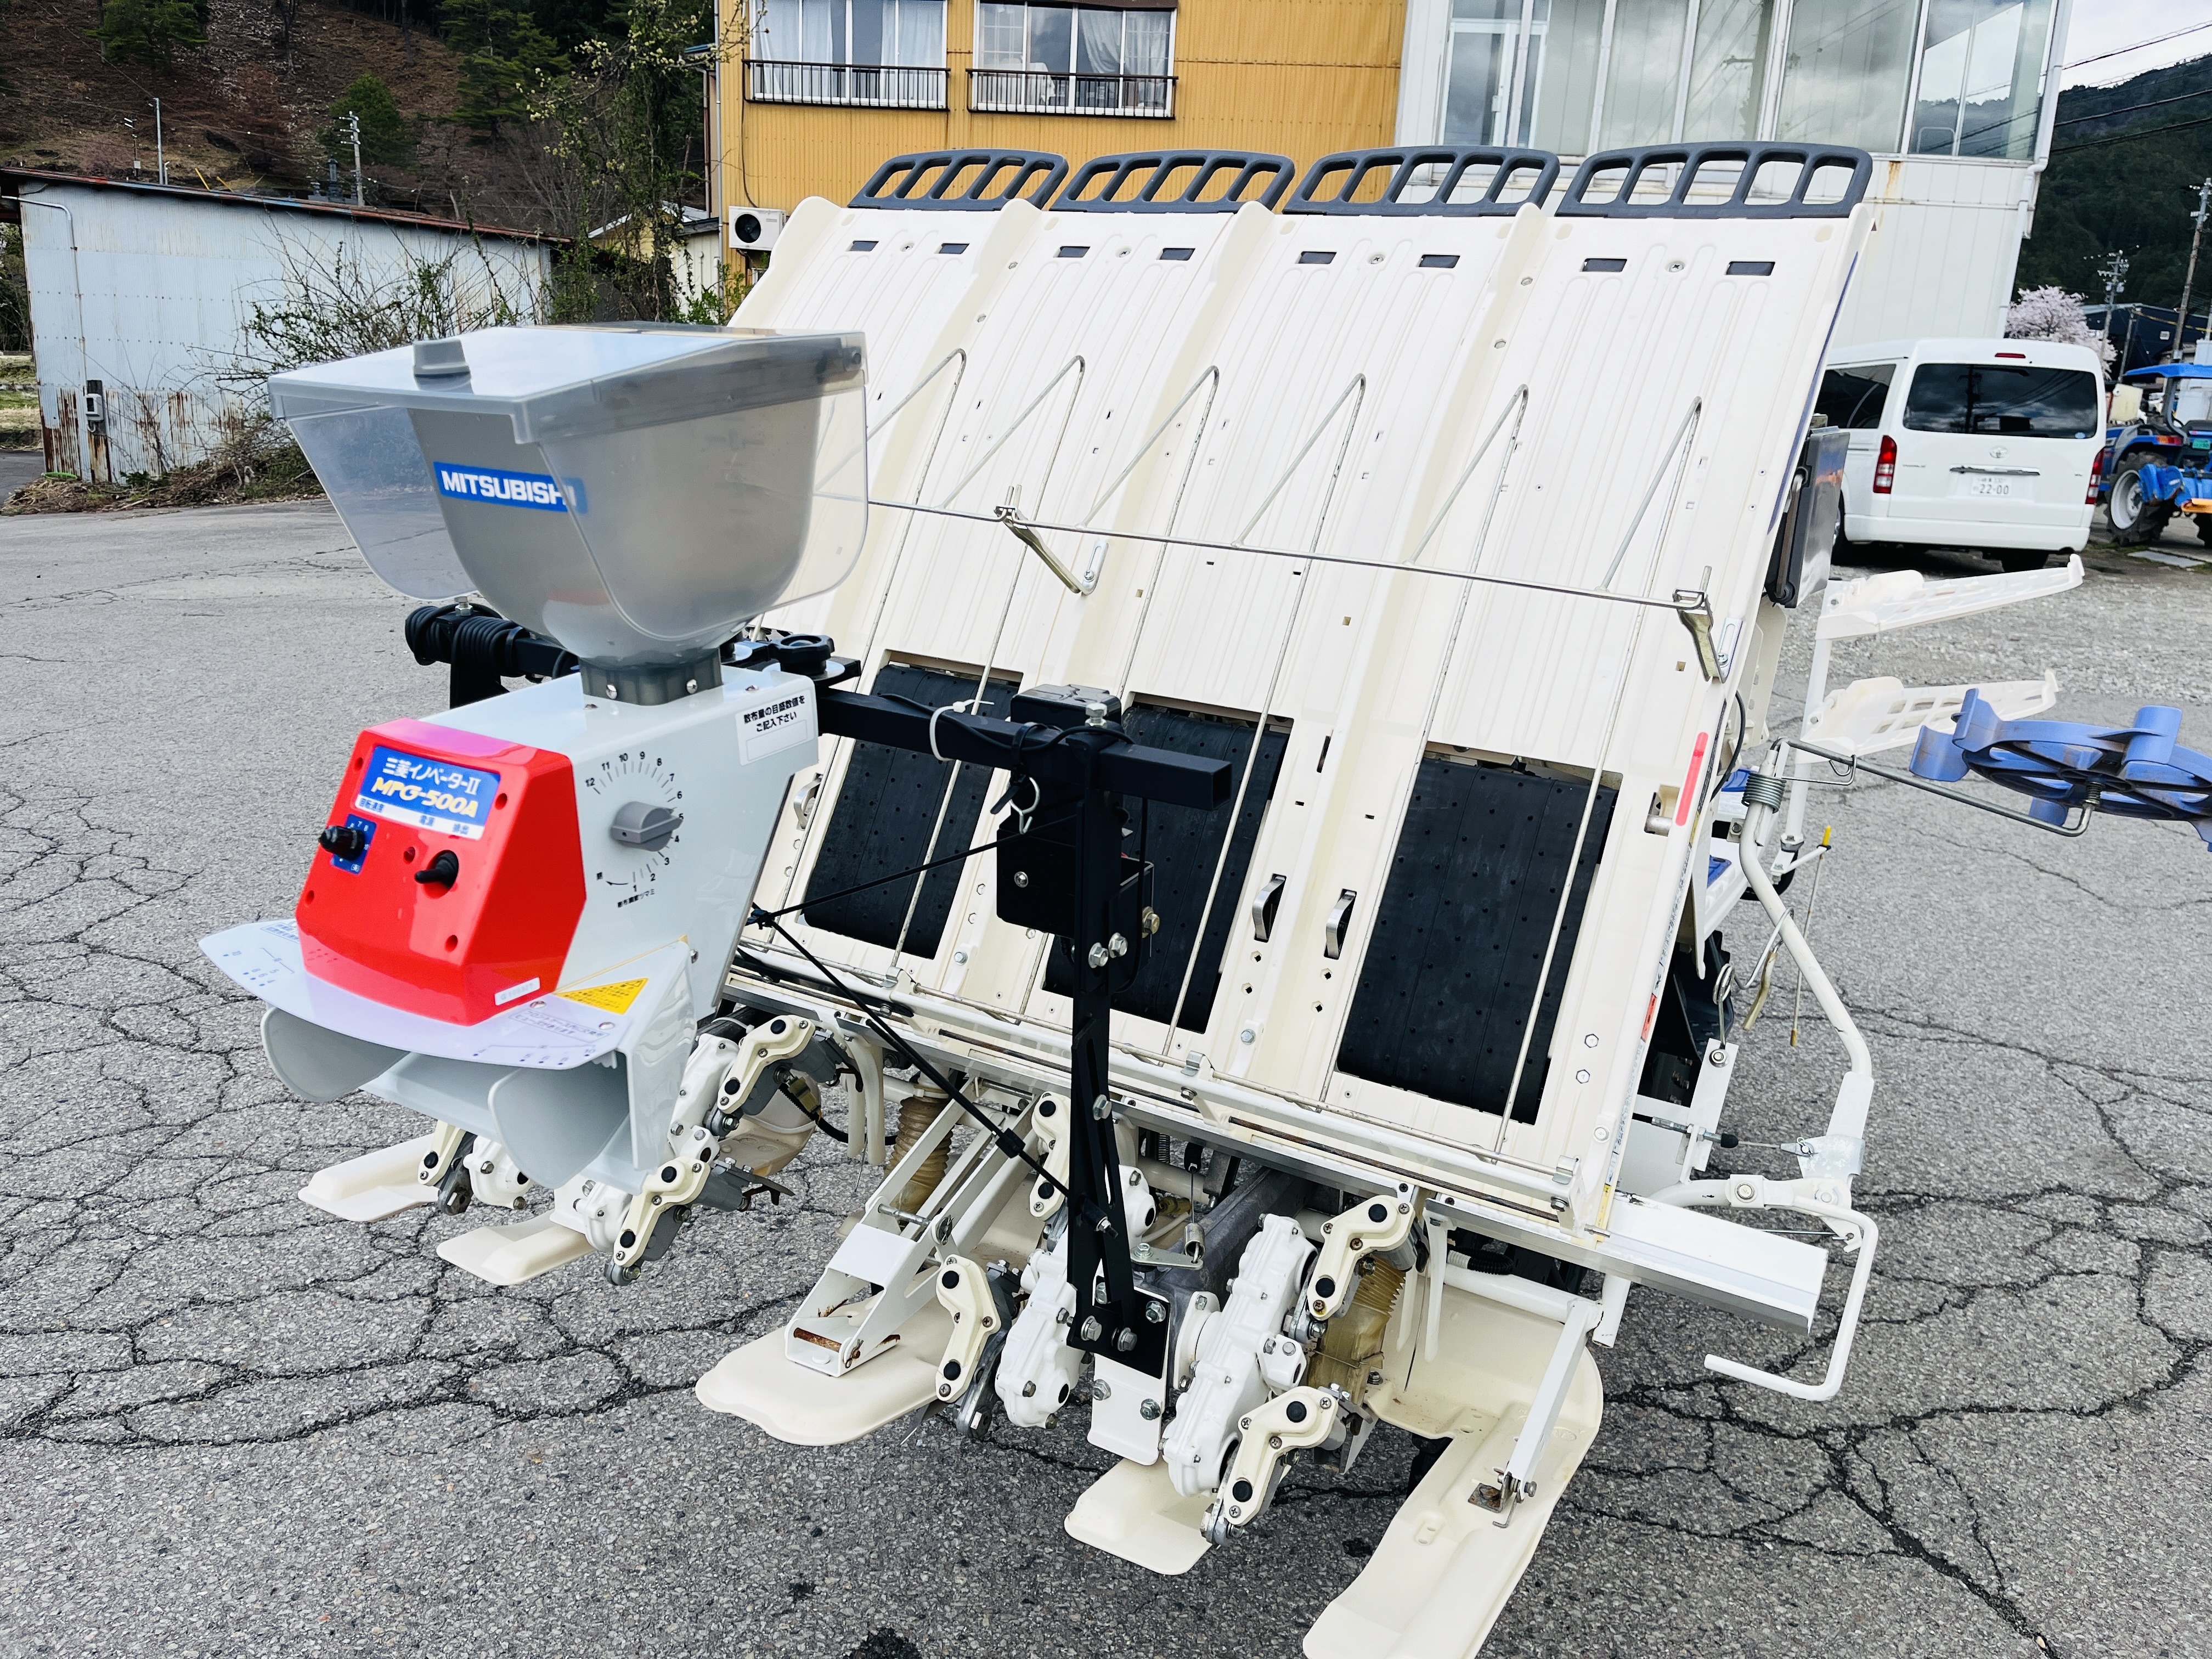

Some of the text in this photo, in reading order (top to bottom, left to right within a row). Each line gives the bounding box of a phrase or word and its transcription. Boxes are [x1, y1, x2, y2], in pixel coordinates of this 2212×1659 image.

[441, 470, 576, 506] MITSUBISHI
[619, 753, 628, 763] 10
[640, 751, 645, 760] 9
[601, 761, 610, 771] 11
[657, 758, 662, 766] 8
[585, 777, 595, 787] 12
[669, 773, 675, 782] 7
[370, 777, 479, 818] MPG-500A
[677, 791, 682, 799] 6
[664, 857, 670, 866] 3
[650, 873, 656, 882] 2
